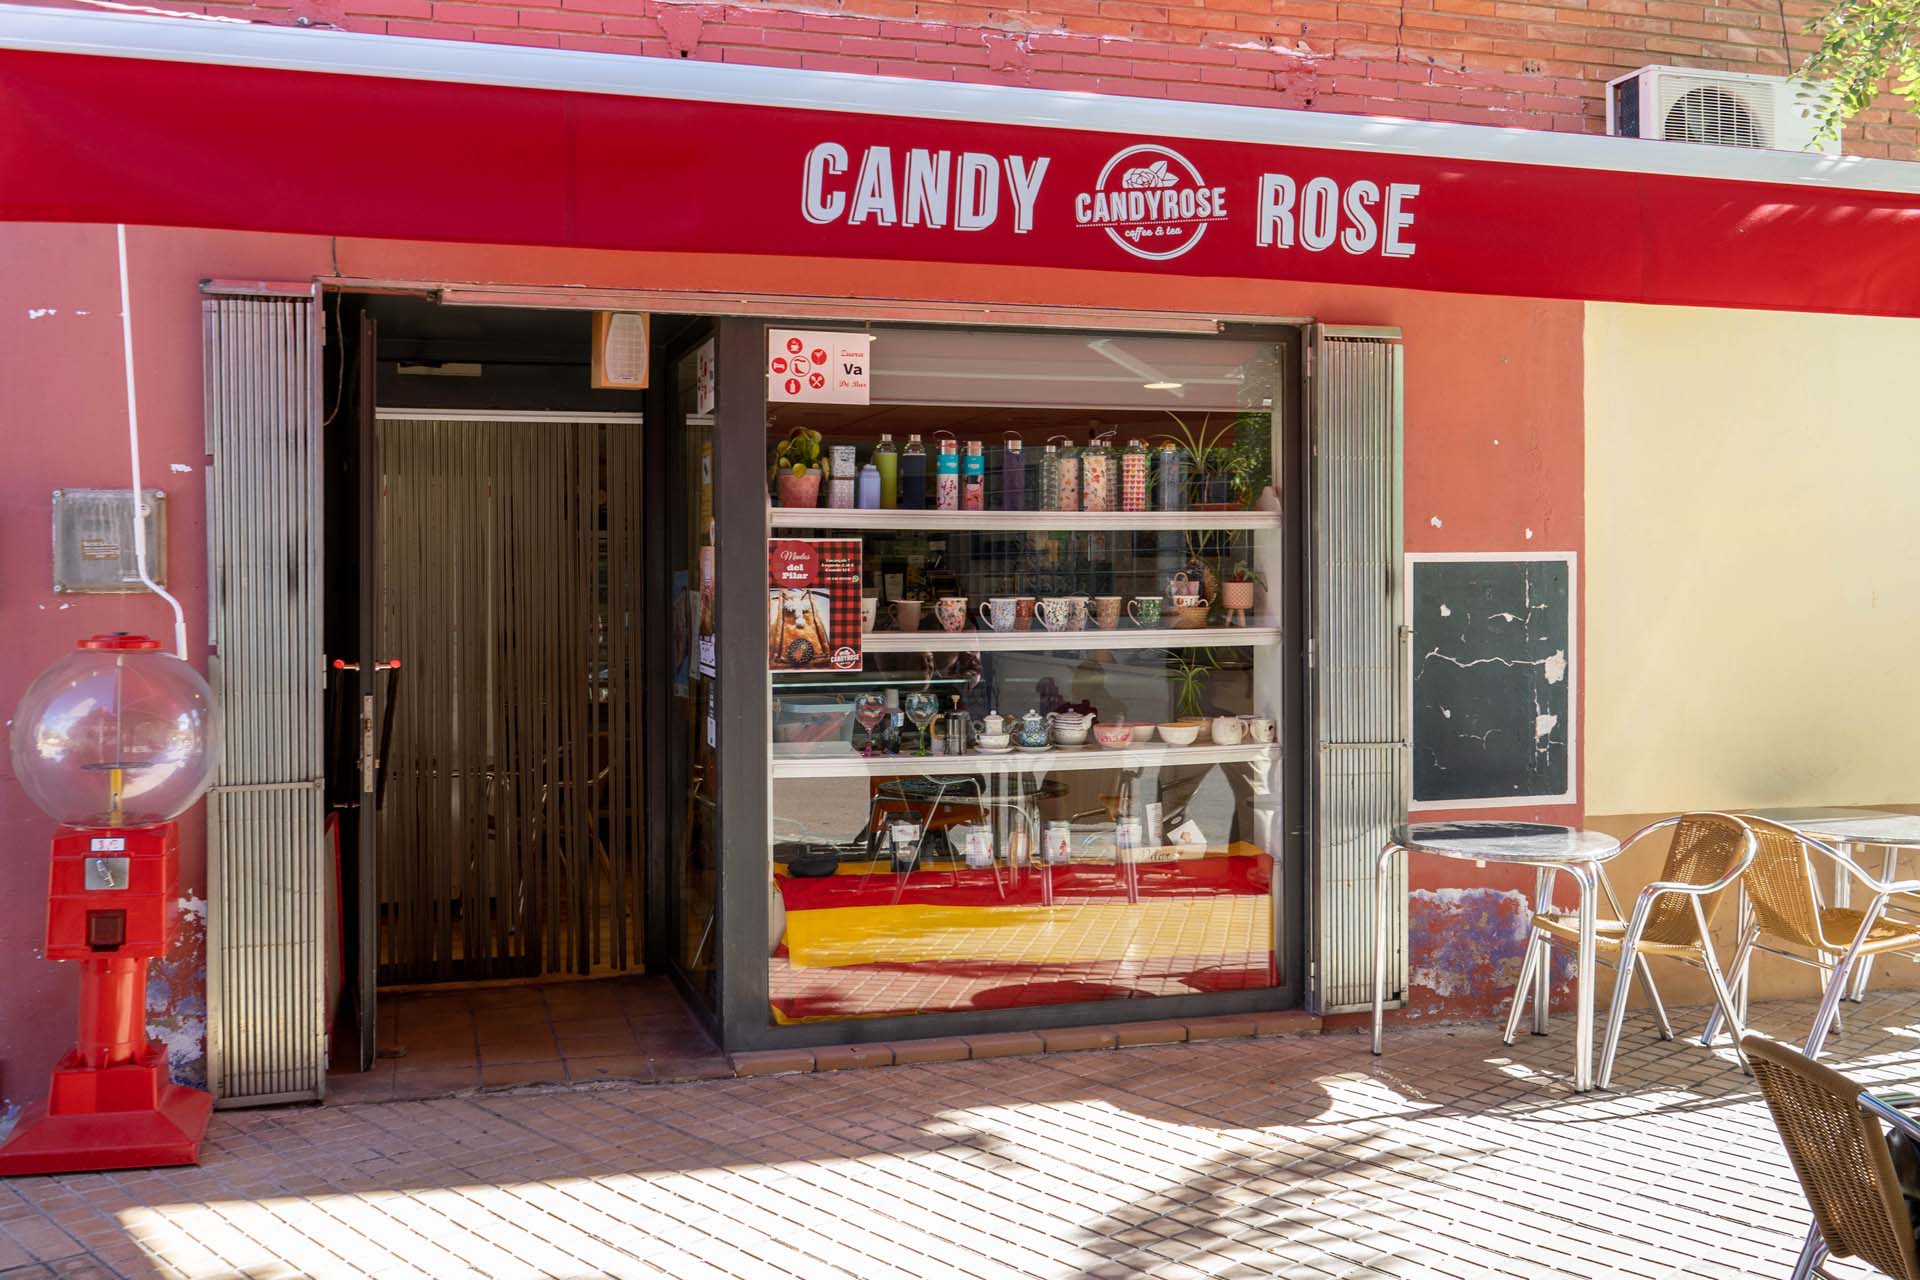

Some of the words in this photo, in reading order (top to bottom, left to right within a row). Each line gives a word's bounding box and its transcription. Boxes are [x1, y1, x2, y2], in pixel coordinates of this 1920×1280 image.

[801, 142, 1051, 235] CANDY
[1256, 173, 1421, 258] ROSE
[1075, 187, 1227, 224] CANDYROSE
[1124, 226, 1153, 242] coffee
[1154, 226, 1165, 236] &
[1166, 226, 1183, 236] tea
[843, 363, 863, 375] Va
[786, 563, 804, 571] del
[781, 572, 809, 580] Pilar
